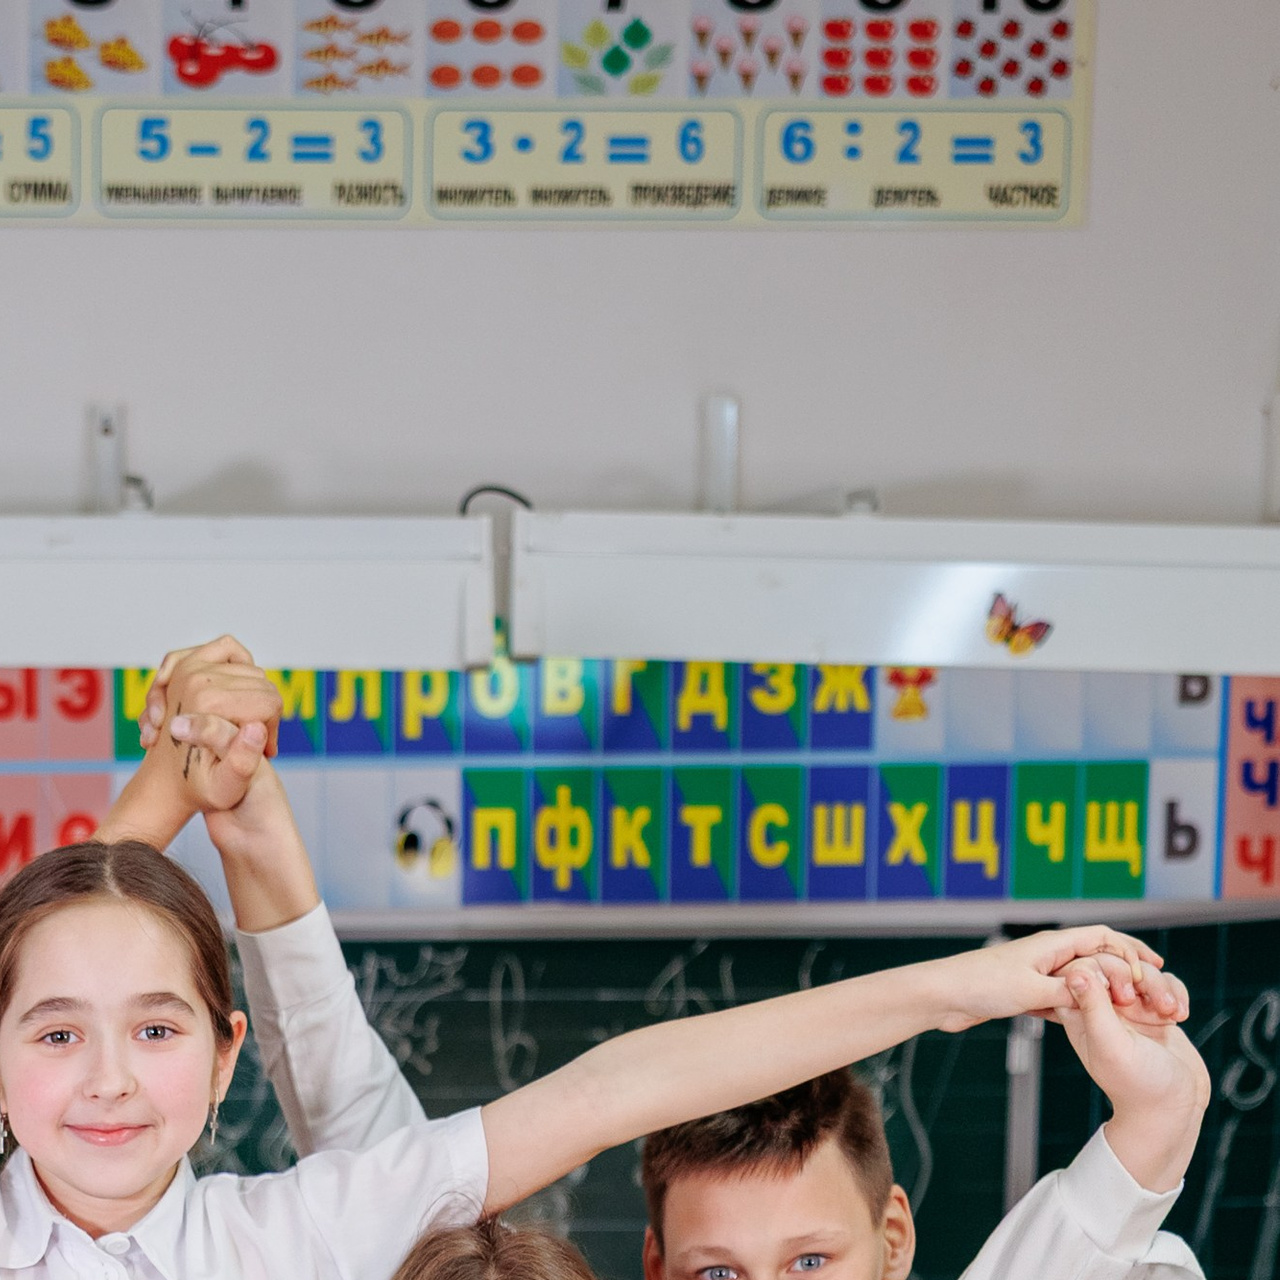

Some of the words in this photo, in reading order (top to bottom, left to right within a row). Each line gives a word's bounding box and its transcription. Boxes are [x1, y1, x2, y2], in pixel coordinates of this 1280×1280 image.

[28, 117, 52, 160] 5
[140, 118, 169, 161] 5
[247, 118, 269, 161] 2
[359, 119, 384, 161] 3
[462, 120, 494, 163] 3
[561, 120, 585, 163] 2
[678, 120, 705, 163] 6
[782, 120, 815, 163] 6
[896, 120, 920, 163] 2
[1019, 121, 1043, 163] 3
